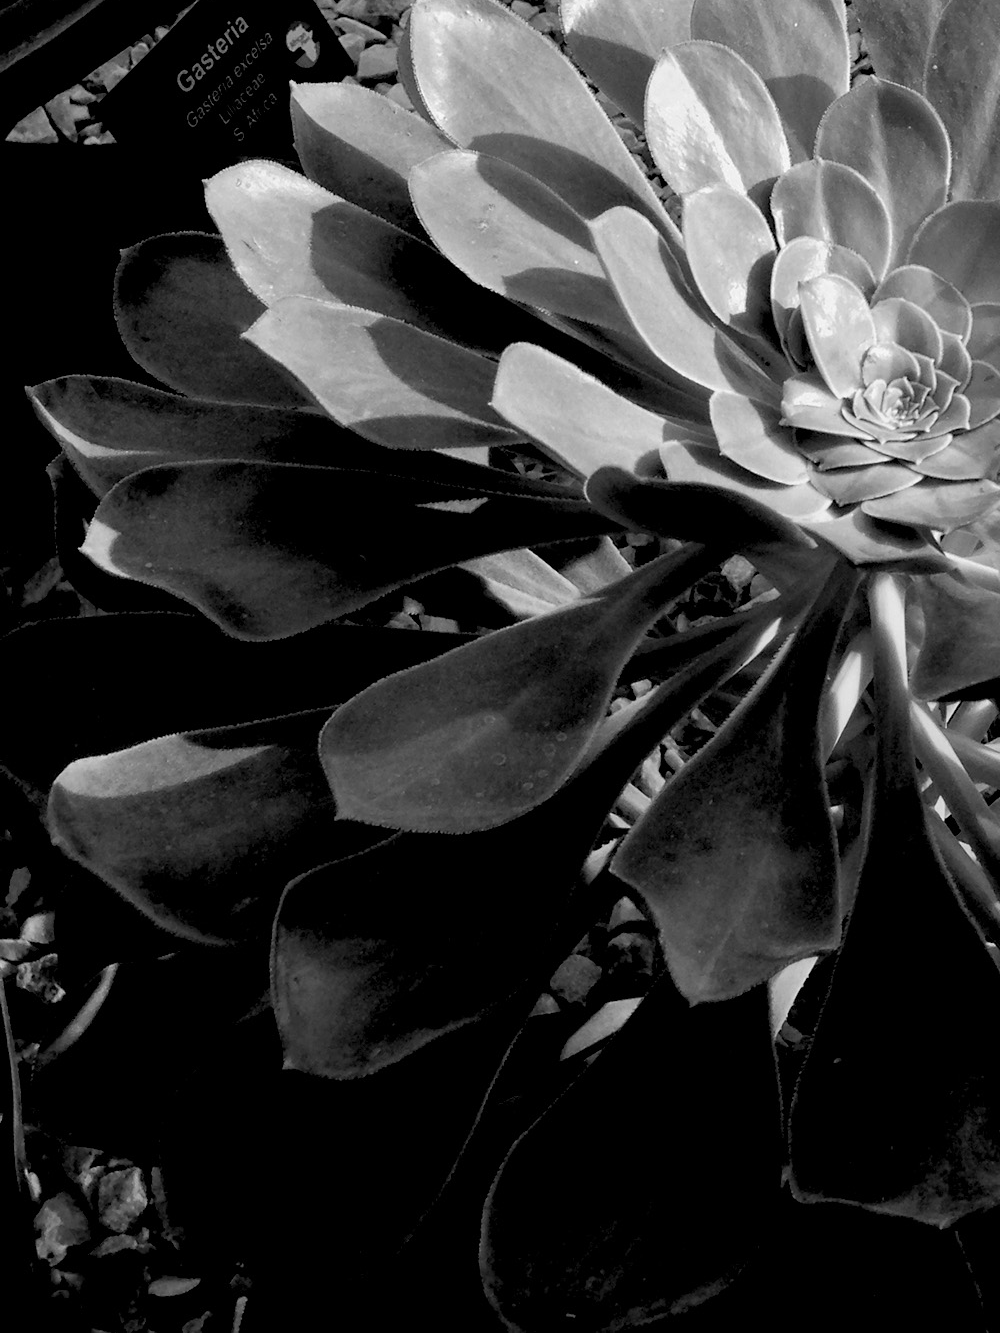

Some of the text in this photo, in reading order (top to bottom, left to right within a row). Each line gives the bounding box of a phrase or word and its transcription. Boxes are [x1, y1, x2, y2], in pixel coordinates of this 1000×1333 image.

[176, 16, 250, 93] Gasteria
[186, 32, 273, 128] Gasteria excelsa
